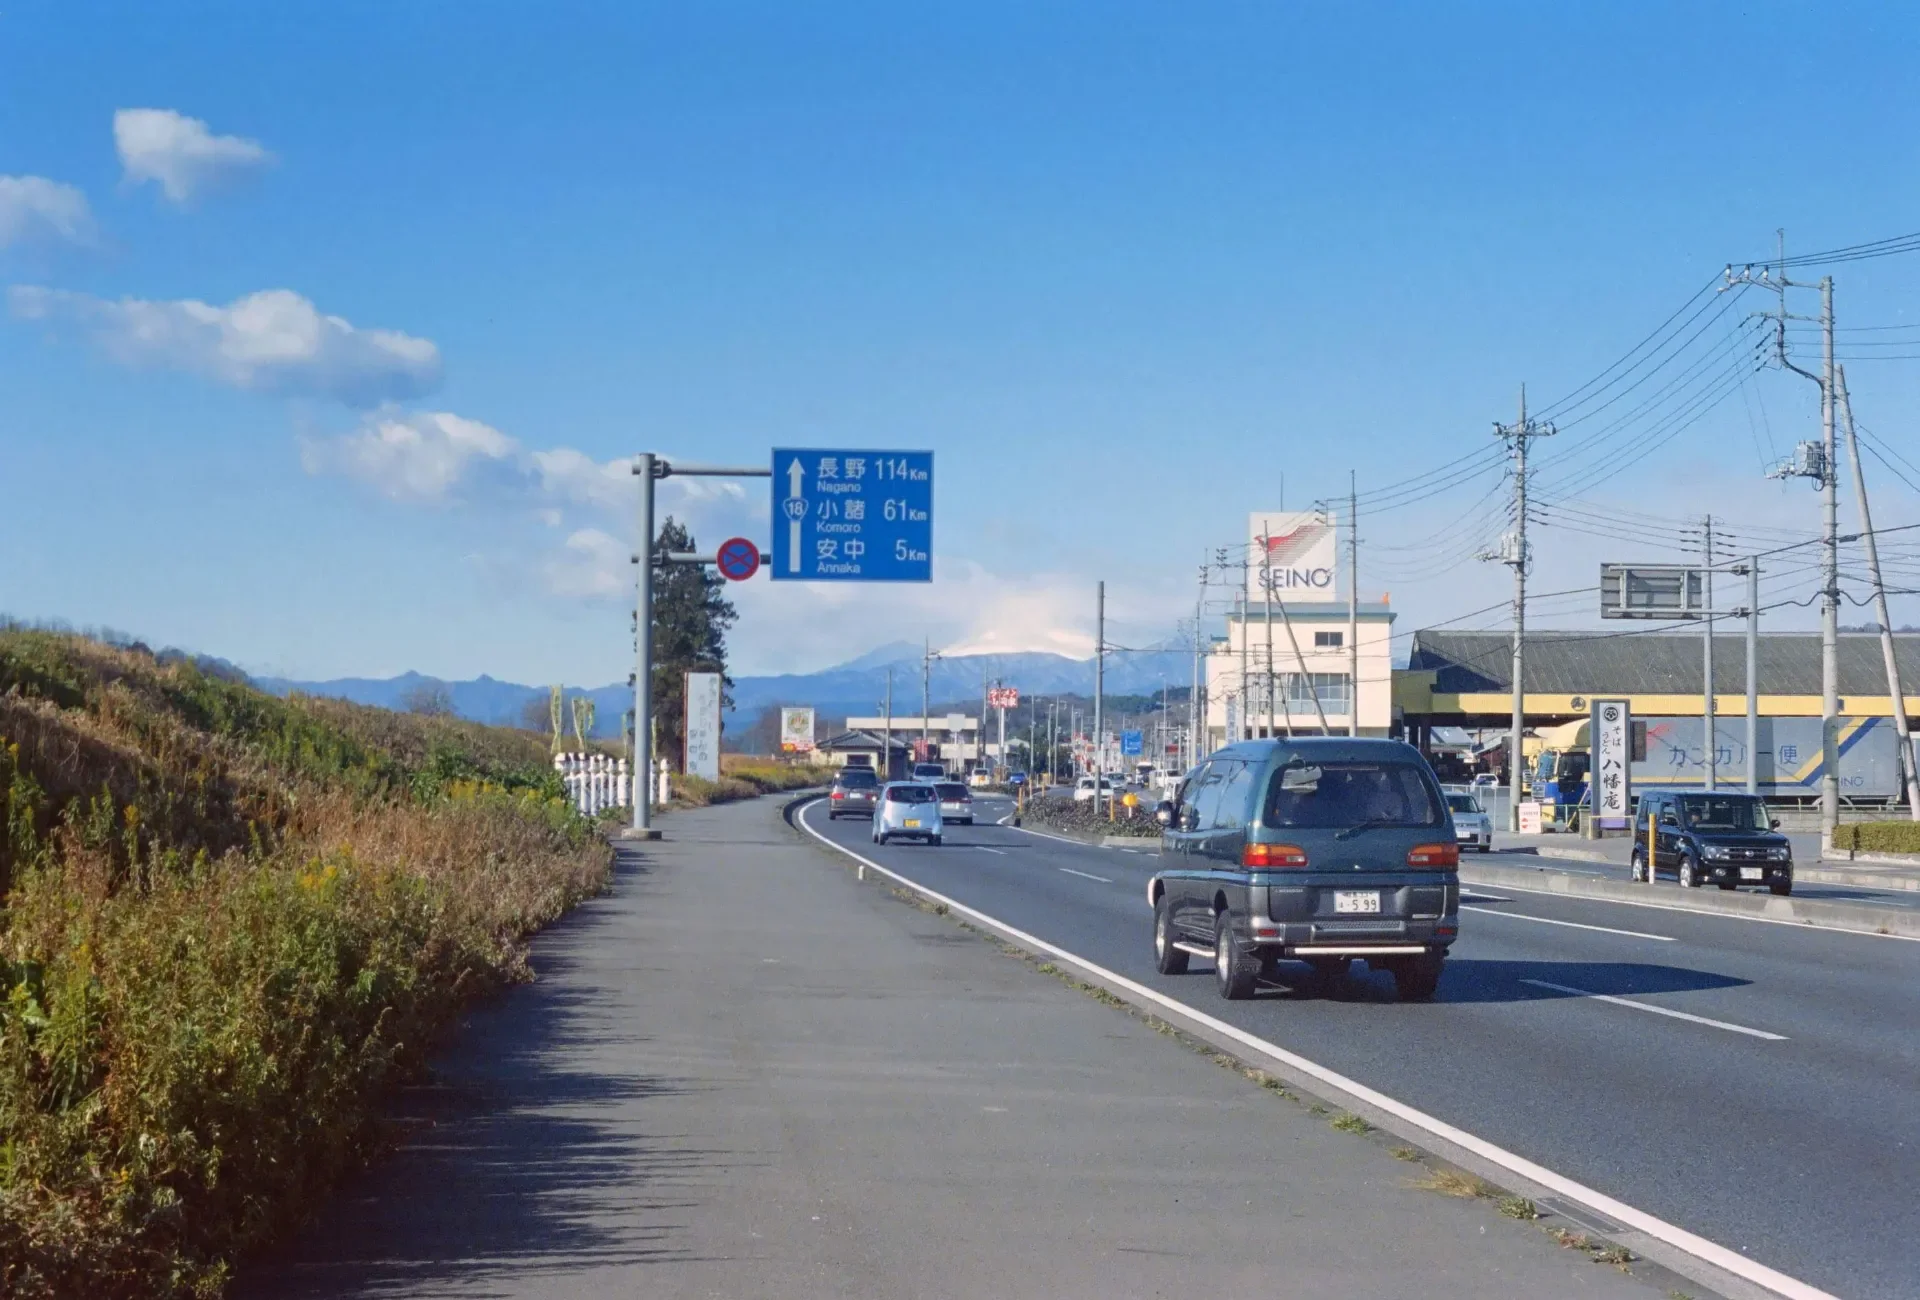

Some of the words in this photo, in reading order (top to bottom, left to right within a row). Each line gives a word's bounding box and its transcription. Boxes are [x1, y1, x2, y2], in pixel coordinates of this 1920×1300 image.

[817, 457, 866, 480] 長野
[817, 481, 862, 494] Nagano
[788, 502, 803, 516] 18
[817, 500, 865, 520] 小諸
[816, 521, 861, 533] Komoro
[817, 538, 865, 560] 安中
[817, 561, 861, 574] Annaka
[1258, 567, 1331, 588] SEINO
[1602, 731, 1611, 755] うどん
[1612, 725, 1622, 747] そば
[1602, 758, 1622, 810] 八幡庵
